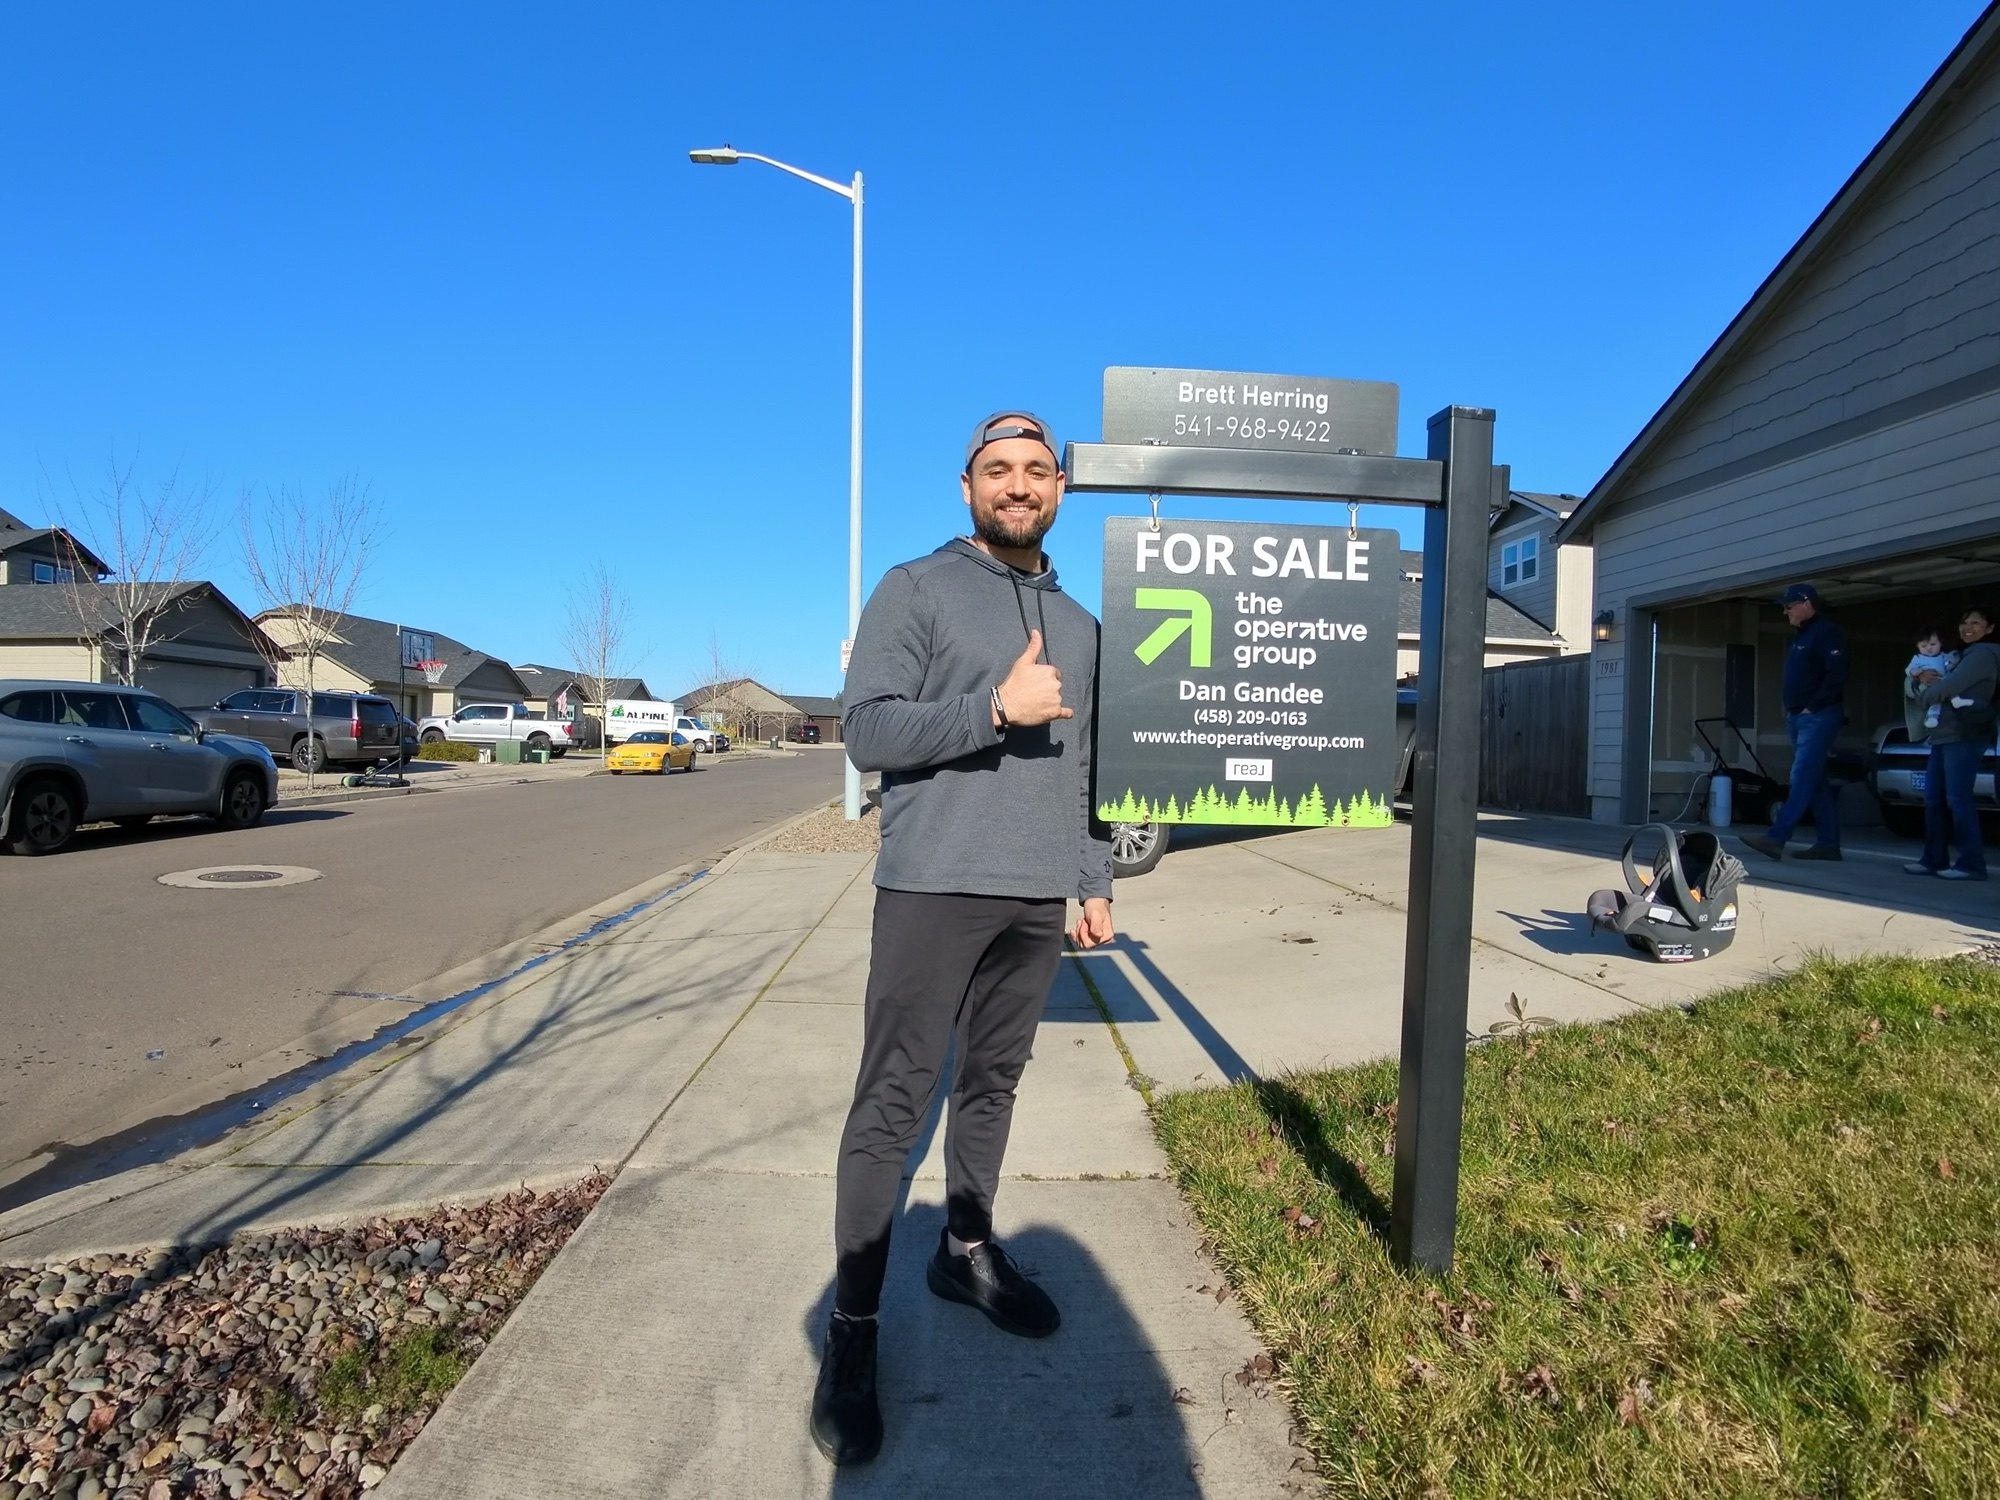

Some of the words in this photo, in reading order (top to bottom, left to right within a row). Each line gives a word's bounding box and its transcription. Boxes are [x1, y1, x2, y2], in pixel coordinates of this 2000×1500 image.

[1178, 381, 1236, 405] Brett
[1242, 384, 1329, 415] Herring
[1174, 414, 1331, 443] 541-968-9422
[1136, 531, 1237, 576] FOR
[1251, 536, 1370, 582] SALE
[1234, 591, 1283, 615] the
[1234, 618, 1368, 643] operative
[1233, 645, 1317, 670] group
[1600, 661, 1618, 675] 1981
[1179, 680, 1226, 702] Dan
[1233, 681, 1324, 705] Gandee
[626, 711, 669, 721] ALPINE
[1194, 708, 1233, 727] (458)
[1236, 709, 1308, 726] 209-0163
[1132, 729, 1365, 752] www.theoperativegroup.com
